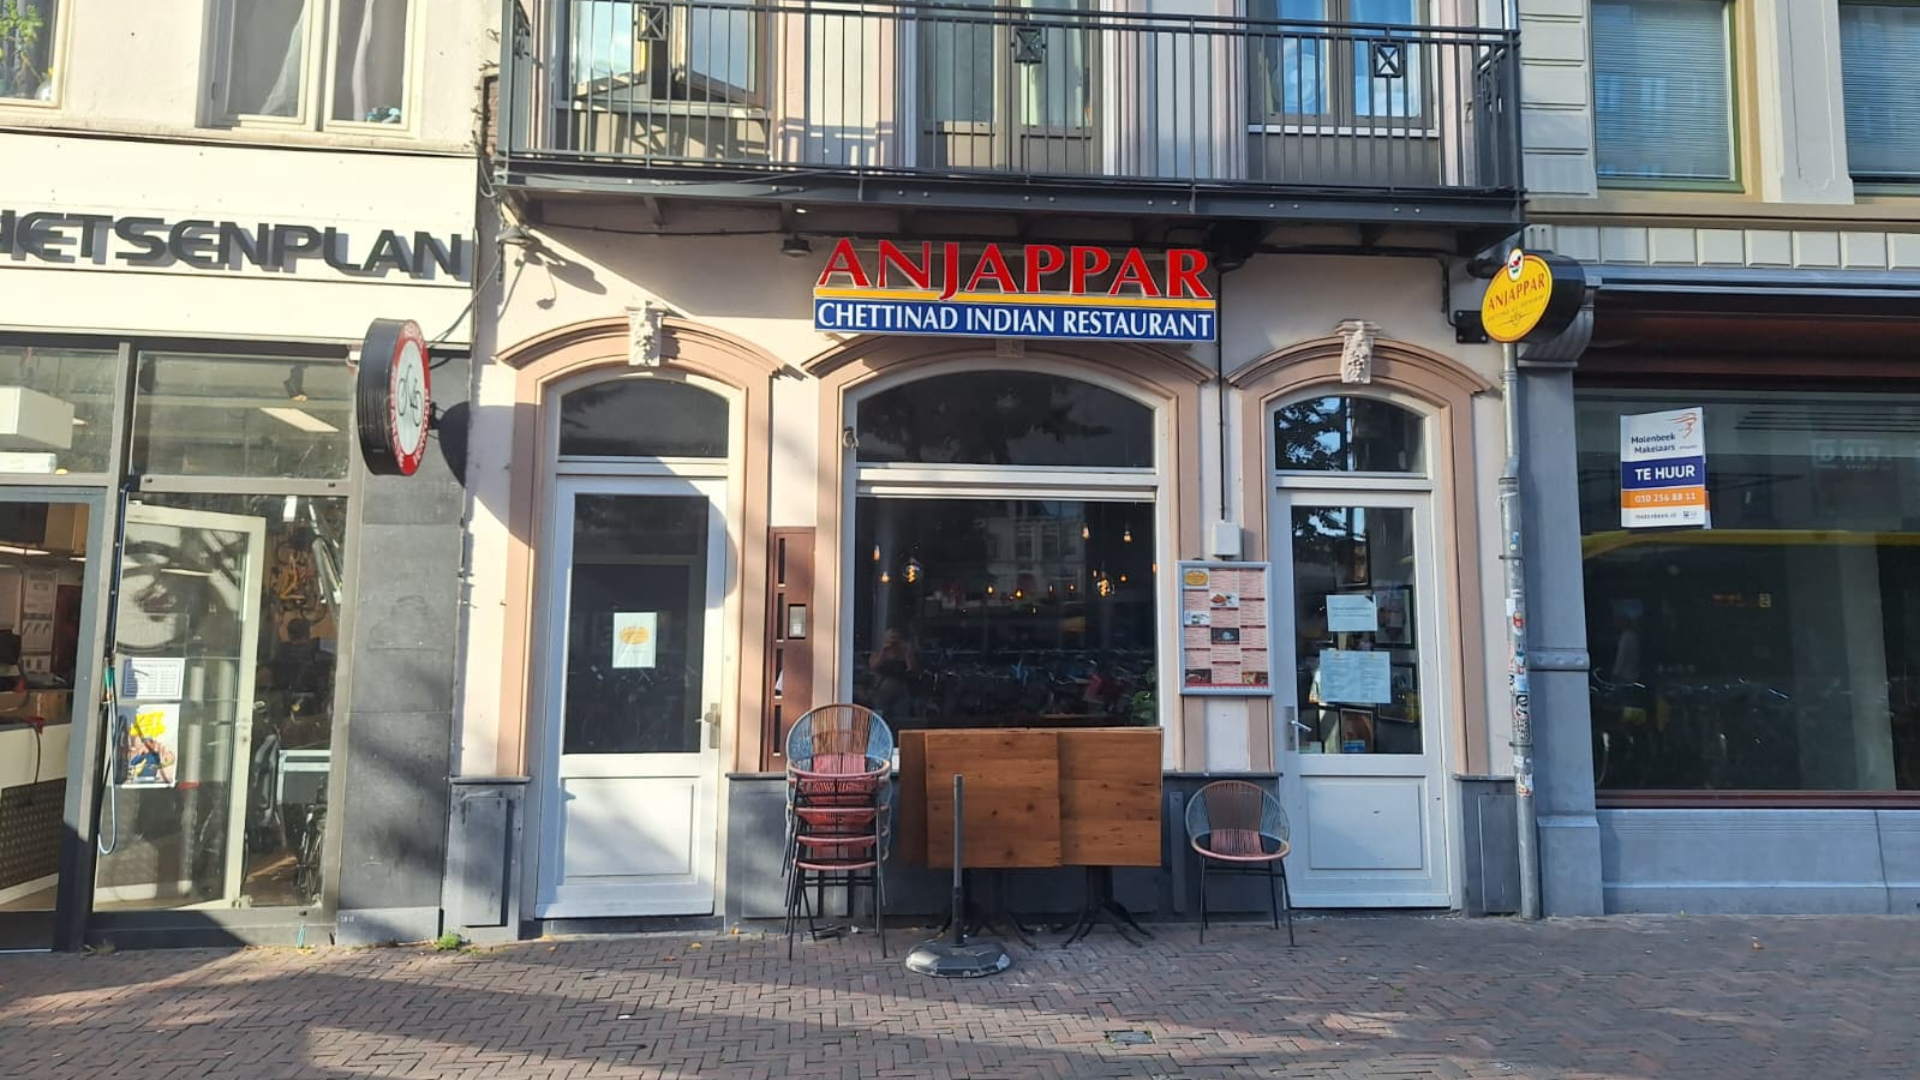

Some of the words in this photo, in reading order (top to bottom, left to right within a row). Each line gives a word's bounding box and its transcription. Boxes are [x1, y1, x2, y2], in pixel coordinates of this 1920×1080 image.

[816, 237, 1213, 301] ANJAPPAR
[1487, 272, 1546, 311] ANJAPPAR
[817, 302, 958, 331] CHETTINAD
[966, 308, 1056, 334] INDIAN
[1063, 310, 1212, 338] RESTAURANT
[1631, 433, 1675, 444] Molenbeek
[1634, 444, 1675, 454] Makelaars
[1635, 468, 1651, 481] TE
[1655, 465, 1695, 479] HUUR
